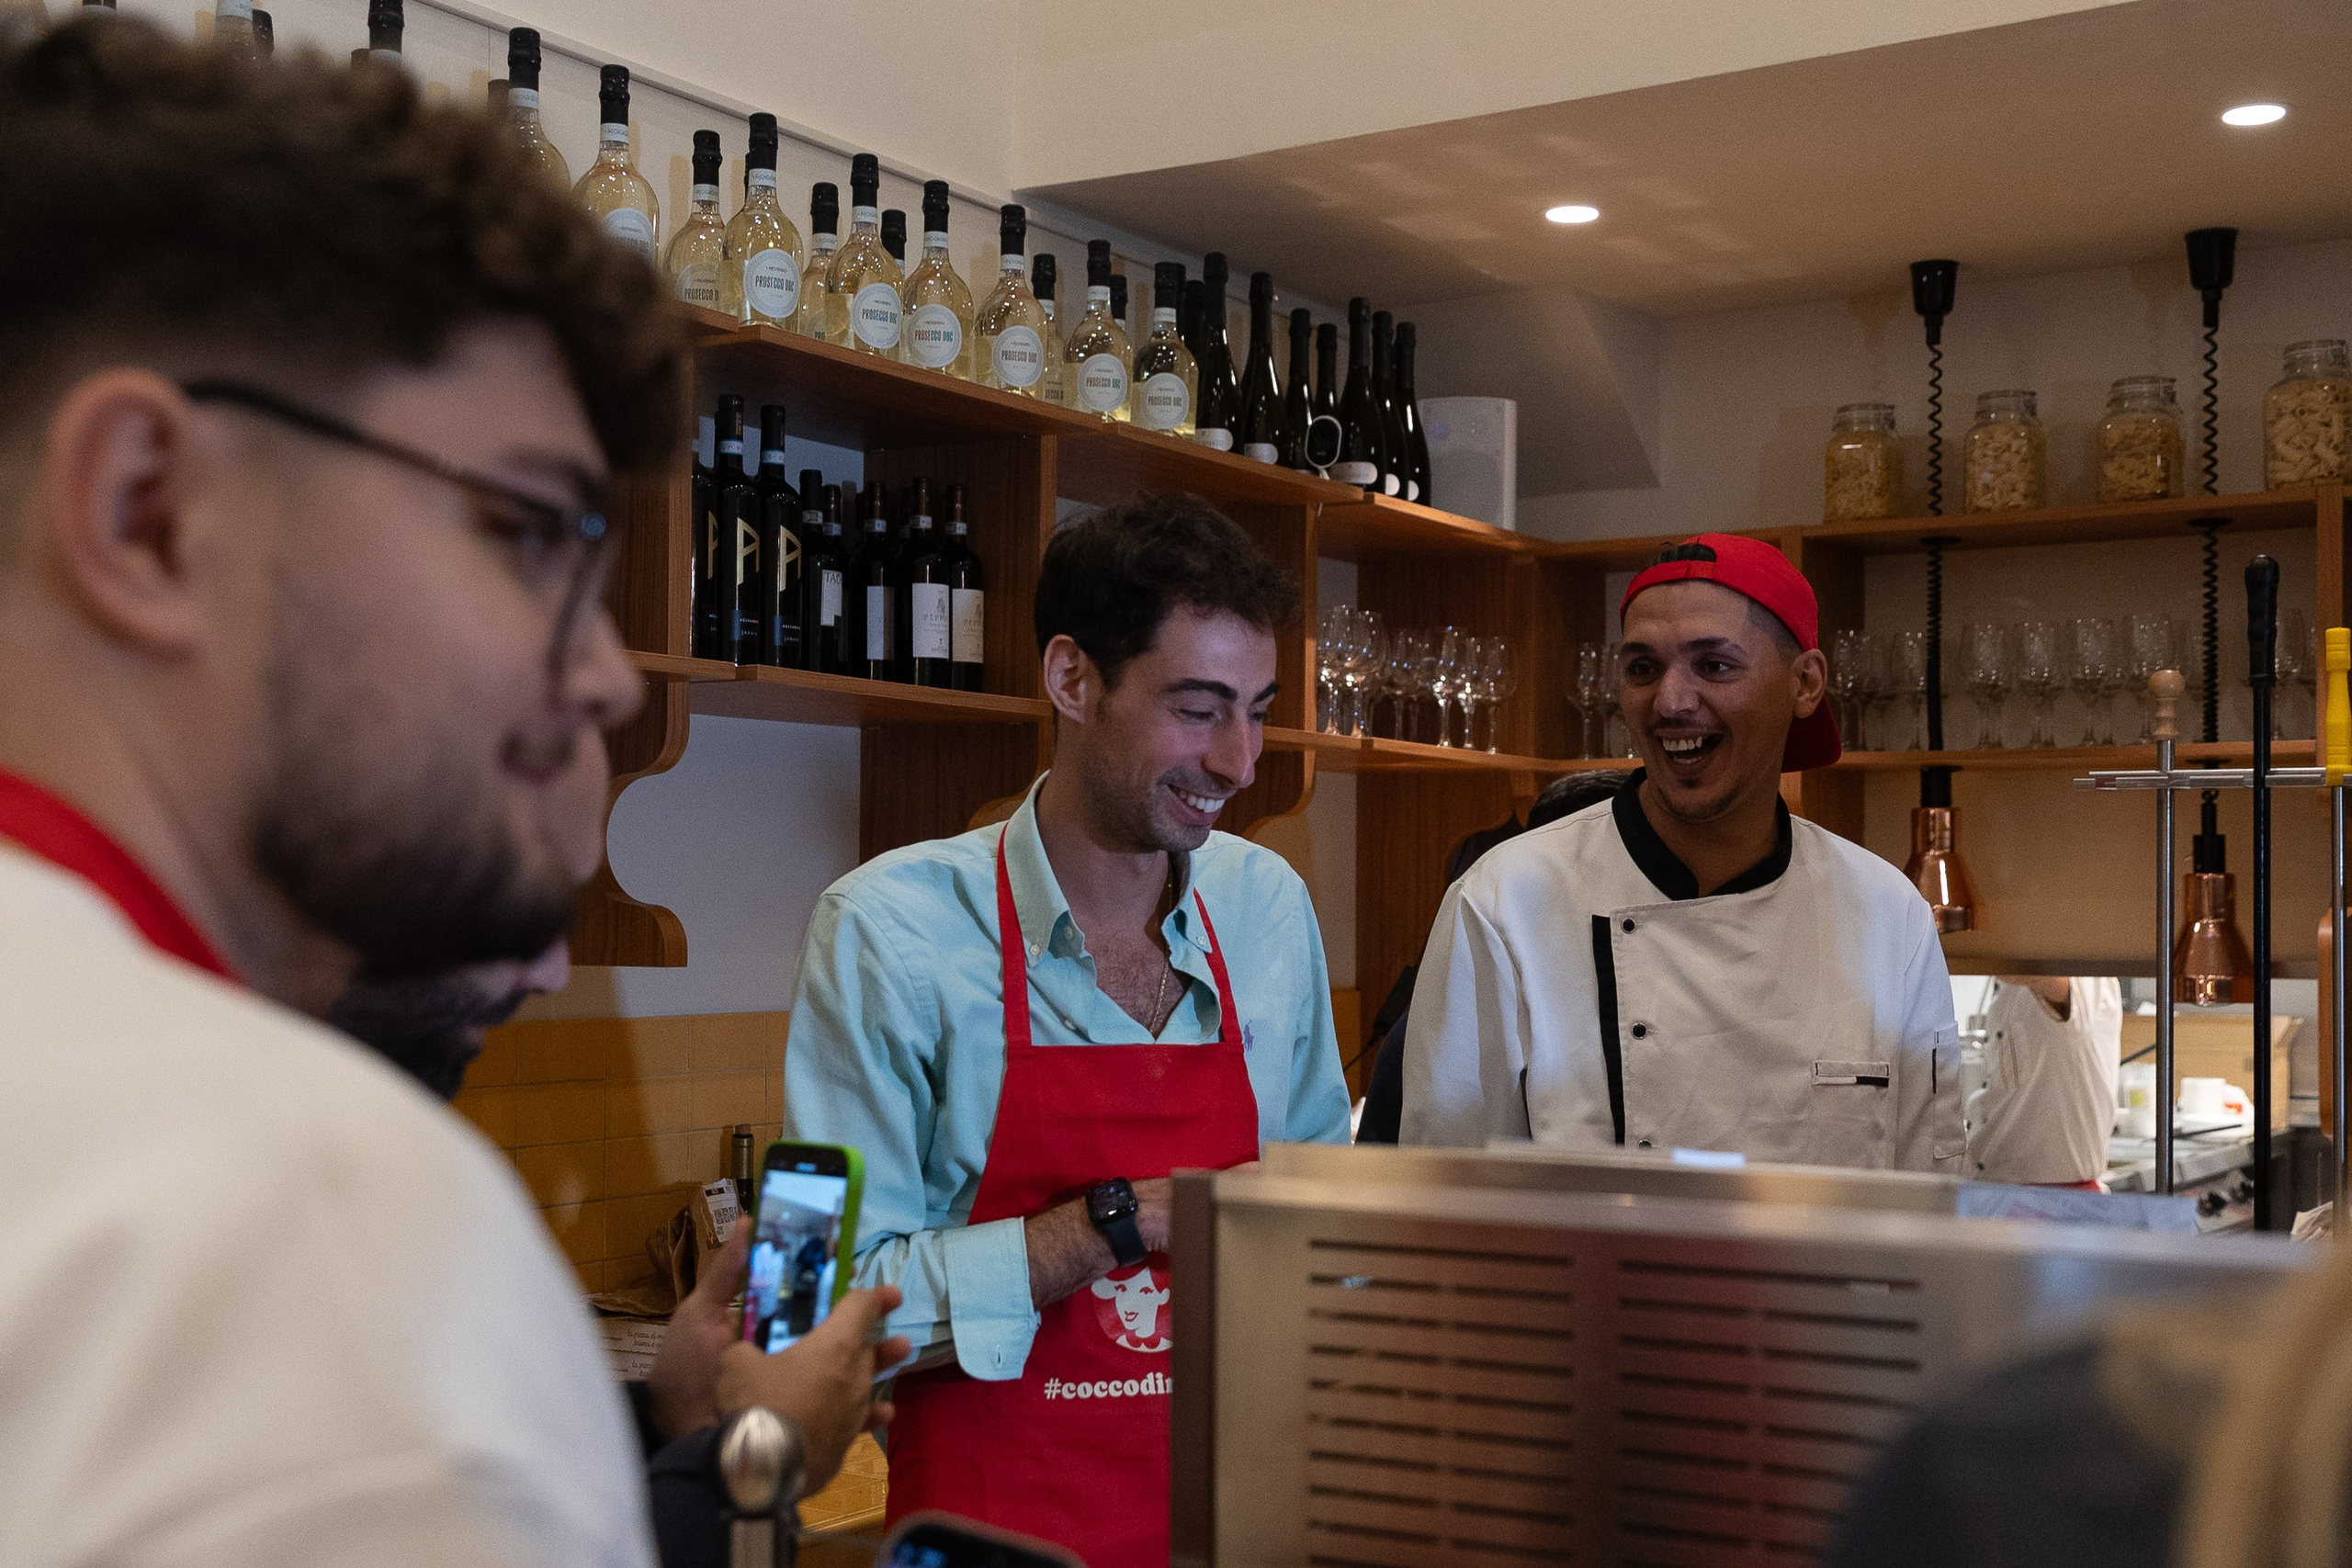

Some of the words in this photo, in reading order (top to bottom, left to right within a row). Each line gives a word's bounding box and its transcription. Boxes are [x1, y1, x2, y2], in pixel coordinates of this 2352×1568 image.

[755, 276, 785, 290] PROSECCO
[785, 279, 795, 293] DOC
[684, 288, 713, 301] PROSECCO
[862, 309, 888, 322] PROSECCO
[915, 330, 942, 342] PROSECCO
[943, 331, 954, 343] DOC
[1001, 350, 1027, 362] PROSECCO
[1086, 376, 1111, 388] PROSECCO
[1148, 395, 1171, 406] PROSECCO
